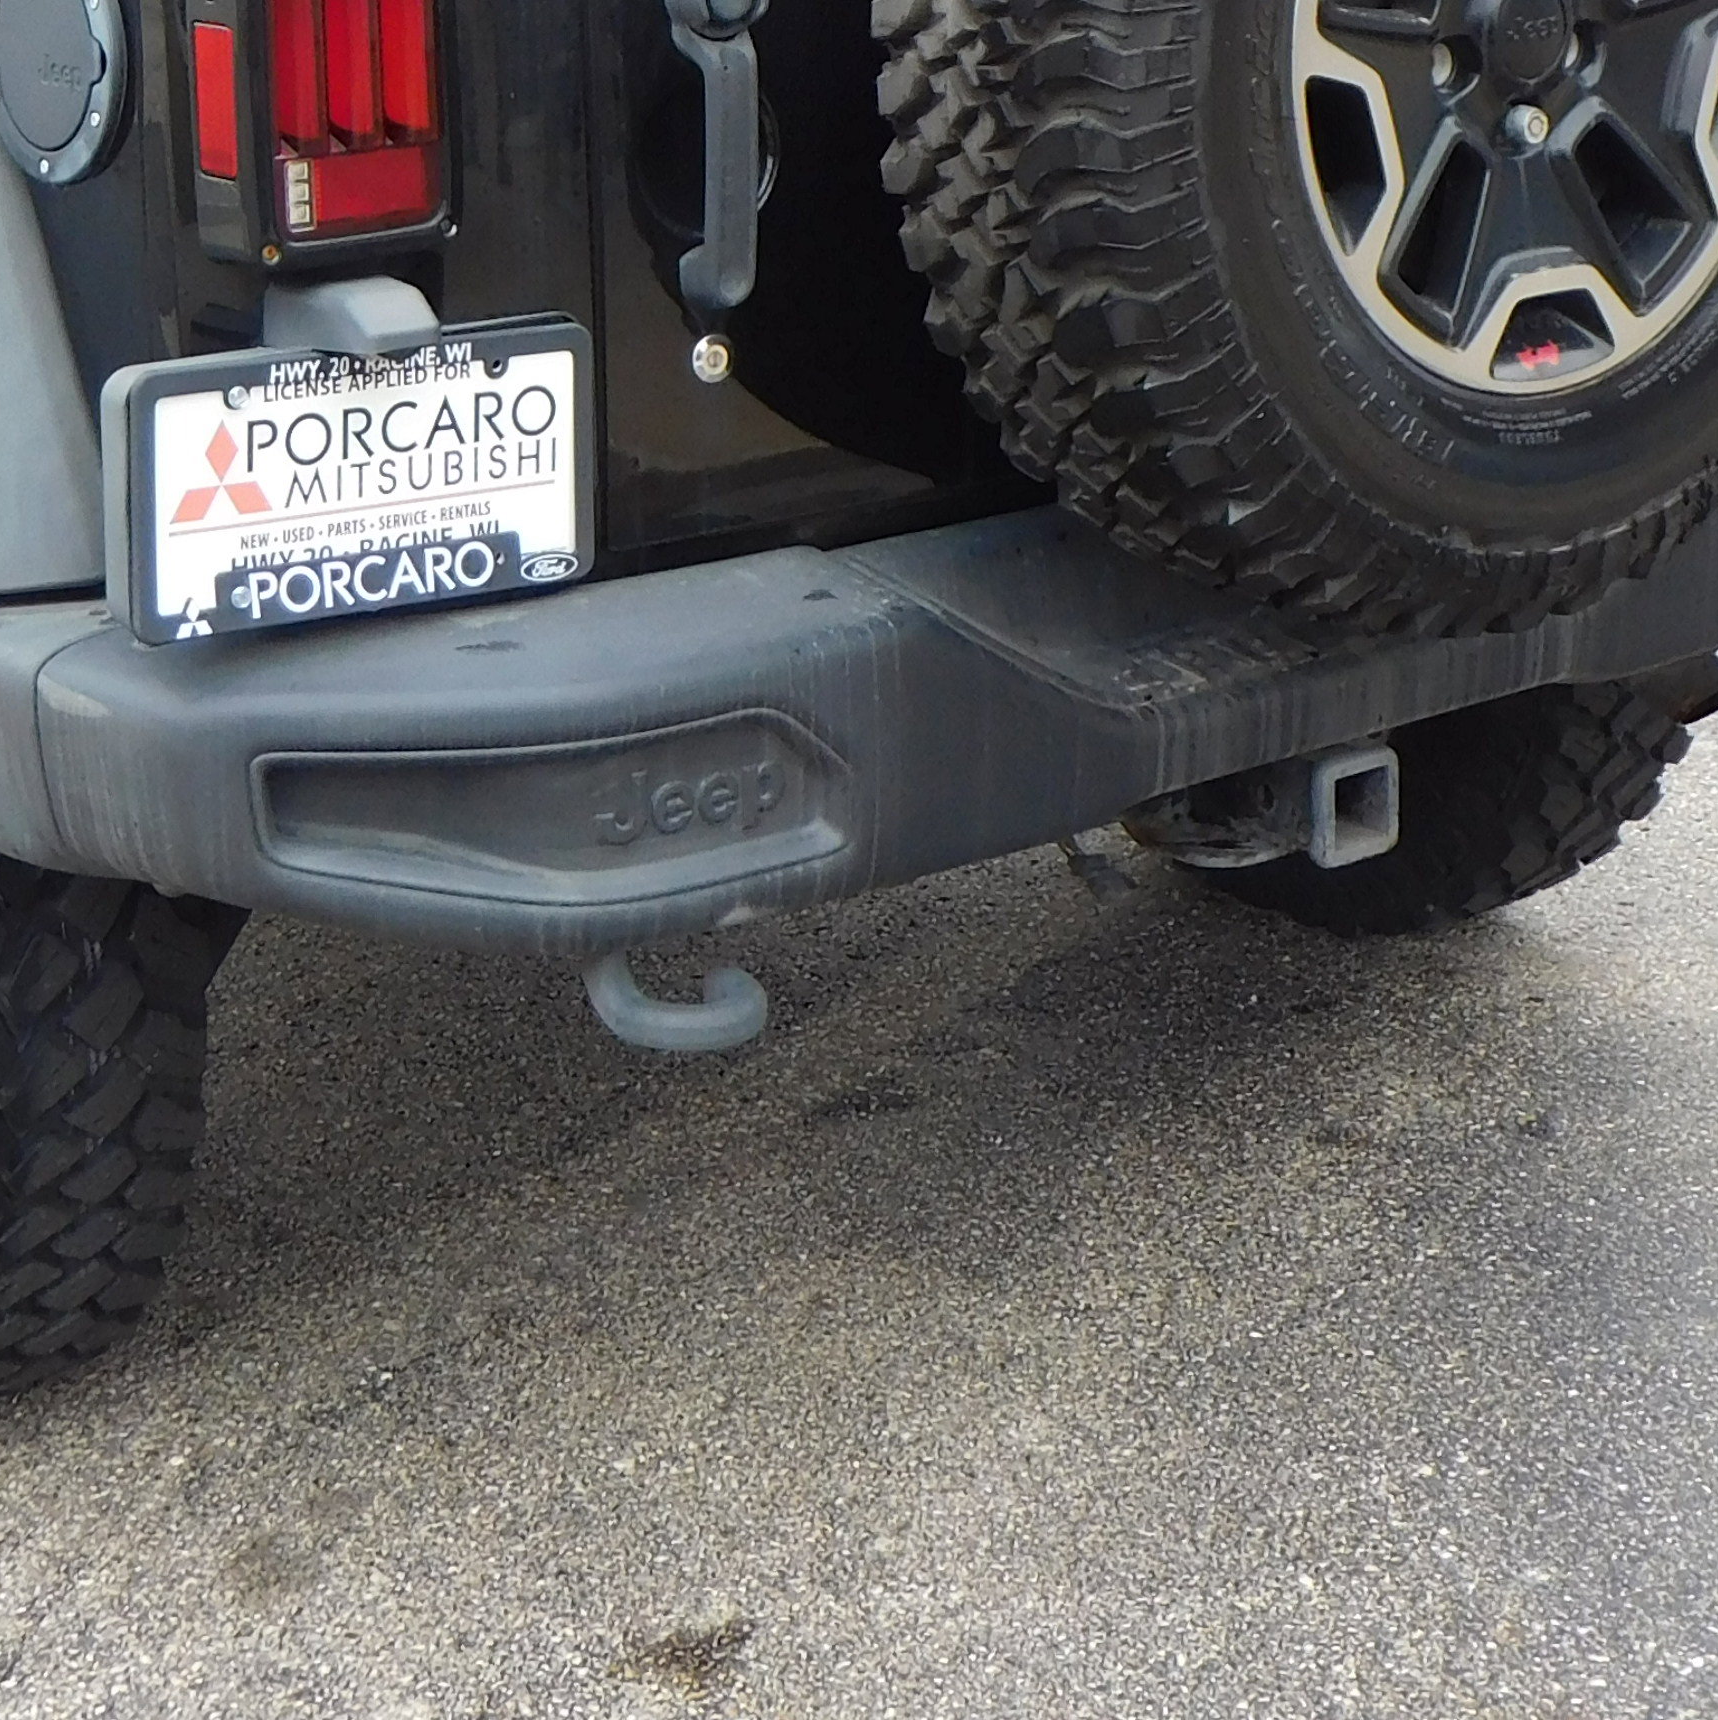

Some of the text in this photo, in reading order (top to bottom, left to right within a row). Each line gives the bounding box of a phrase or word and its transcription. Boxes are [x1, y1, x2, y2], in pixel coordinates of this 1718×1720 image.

[37, 53, 83, 92] Jeep
[263, 360, 471, 402] LICENSE APPLIED FOR
[270, 360, 325, 384] HWY.
[329, 355, 350, 378] 20
[444, 342, 472, 362] WI
[246, 385, 556, 472] PORCARO
[285, 437, 556, 508] MITSUBISHI
[240, 500, 491, 550] NEW USED PARTS SERVICE RENTALS
[248, 540, 568, 619] PORCARO Ford
[591, 759, 784, 847] Jeep
